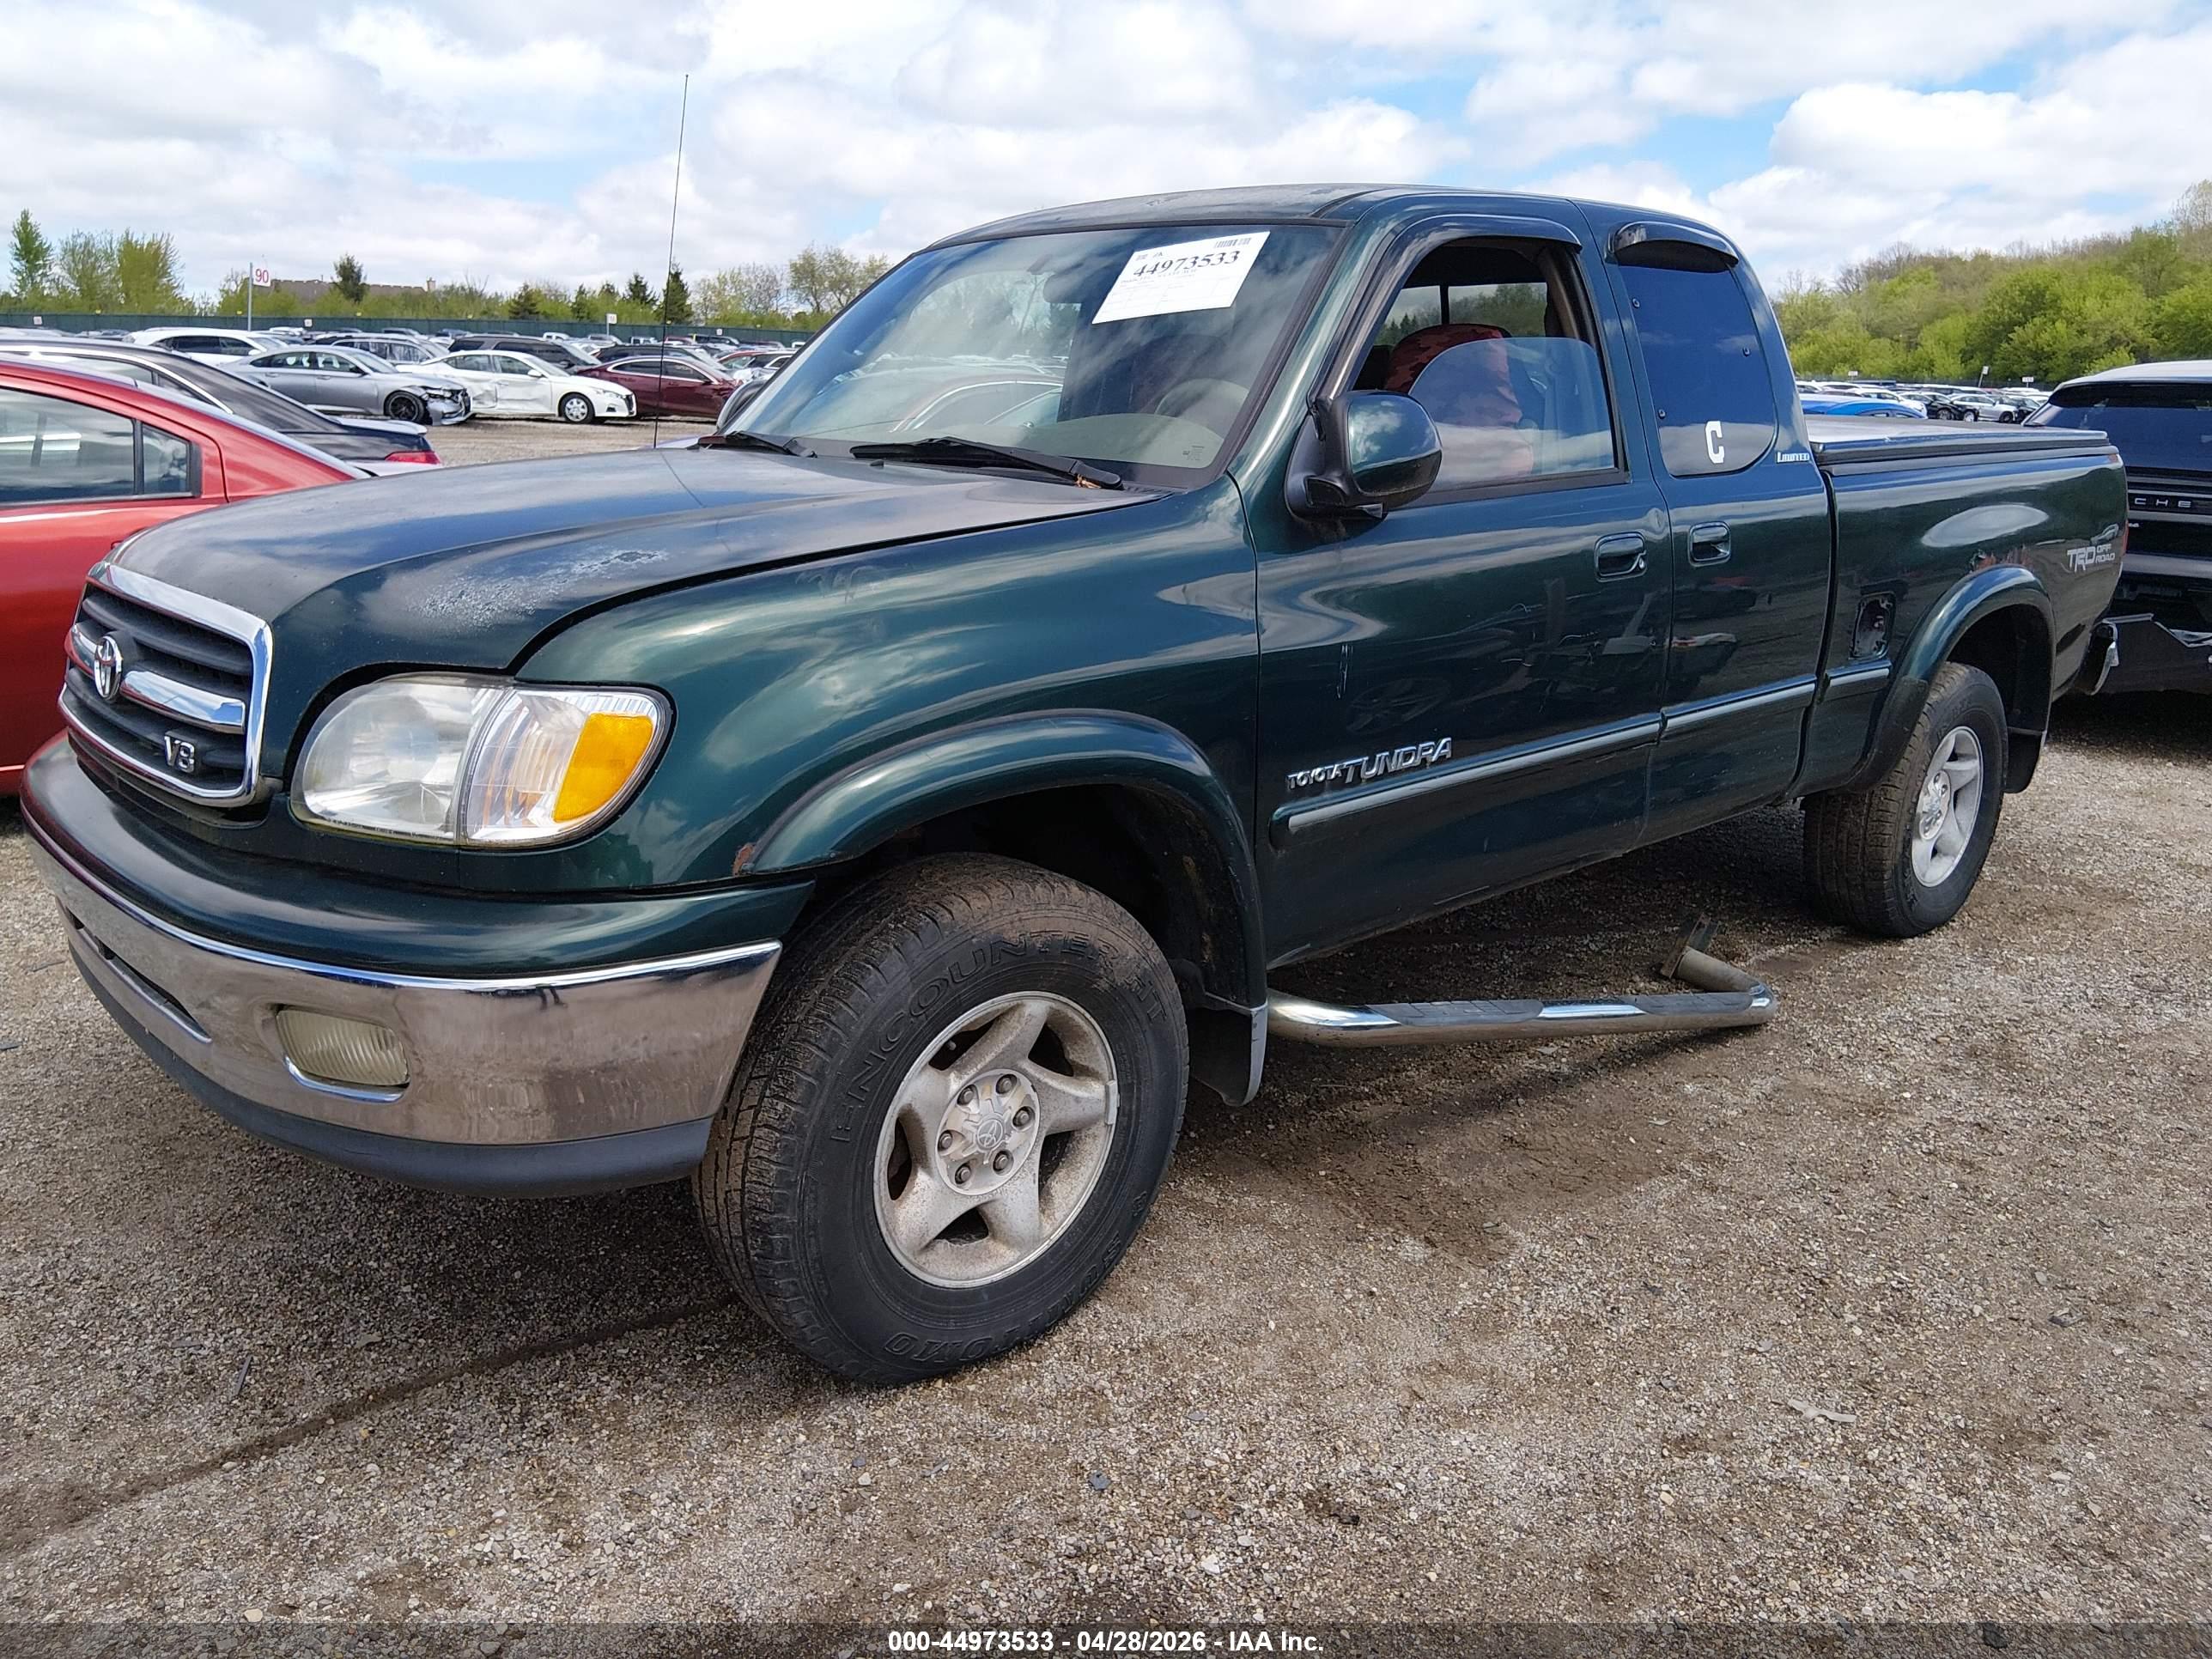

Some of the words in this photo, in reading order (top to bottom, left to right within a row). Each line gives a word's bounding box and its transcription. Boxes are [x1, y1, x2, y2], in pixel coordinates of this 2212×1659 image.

[255, 268, 269, 283] 90
[1133, 250, 1240, 276] 44973533
[1705, 420, 1725, 464] C
[2067, 546, 2096, 573] TRD
[2095, 553, 2115, 563] ROAD
[2097, 544, 2112, 553] OFF
[164, 735, 195, 773] V8
[1287, 763, 1343, 790] TOYOTA
[1340, 737, 1453, 784] TUNDRA
